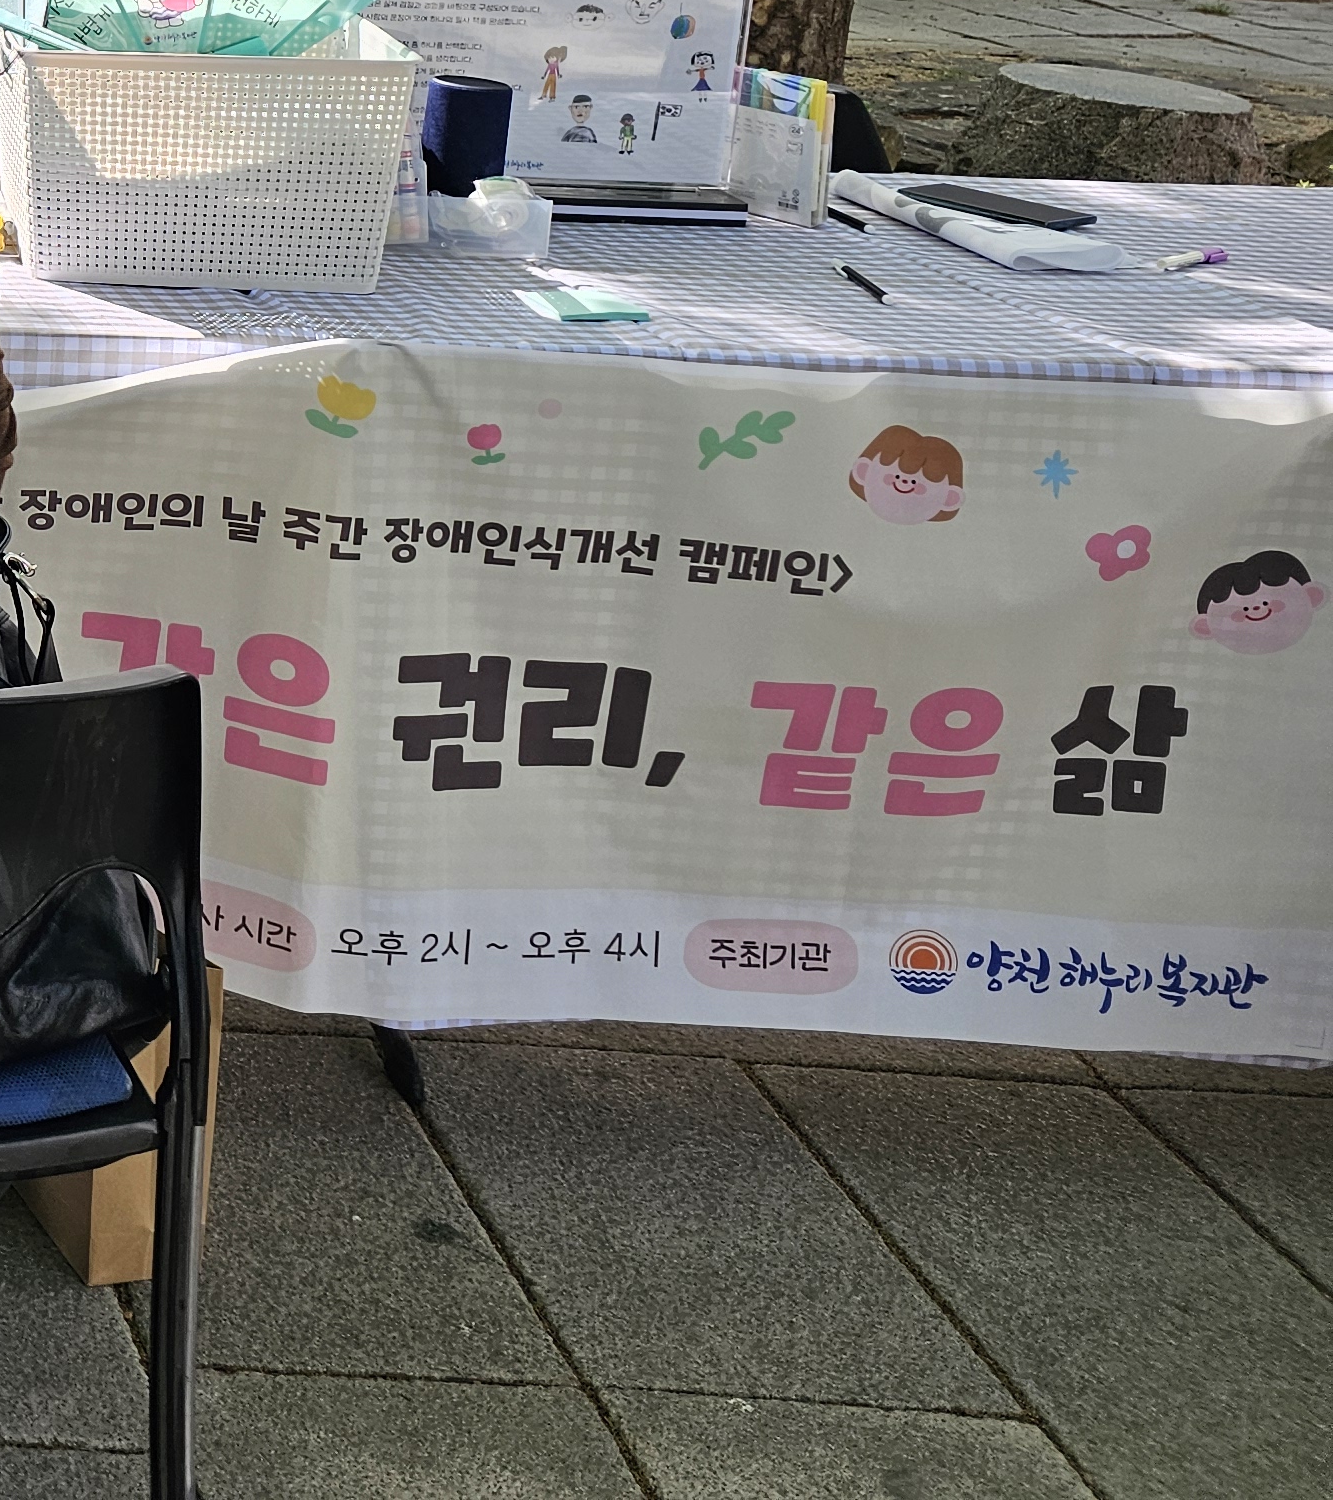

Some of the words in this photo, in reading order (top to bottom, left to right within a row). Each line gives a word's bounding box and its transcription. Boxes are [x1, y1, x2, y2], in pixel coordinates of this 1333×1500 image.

[790, 126, 802, 136] 24
[18, 489, 205, 531] 장애인의
[221, 496, 267, 544] 날
[282, 506, 368, 561] 주간
[383, 516, 661, 577] 장애인식개선
[678, 537, 854, 597] 캠페인>
[393, 652, 686, 791] 권리,
[750, 681, 1005, 817] 같은
[1050, 684, 1189, 817] 삶
[234, 915, 298, 954] 시간
[330, 926, 409, 967] 오후
[420, 927, 473, 966] 2시
[521, 927, 591, 966] 오후
[603, 929, 662, 968] 4시
[707, 937, 832, 973] 주최기관
[966, 939, 1053, 995] 양천
